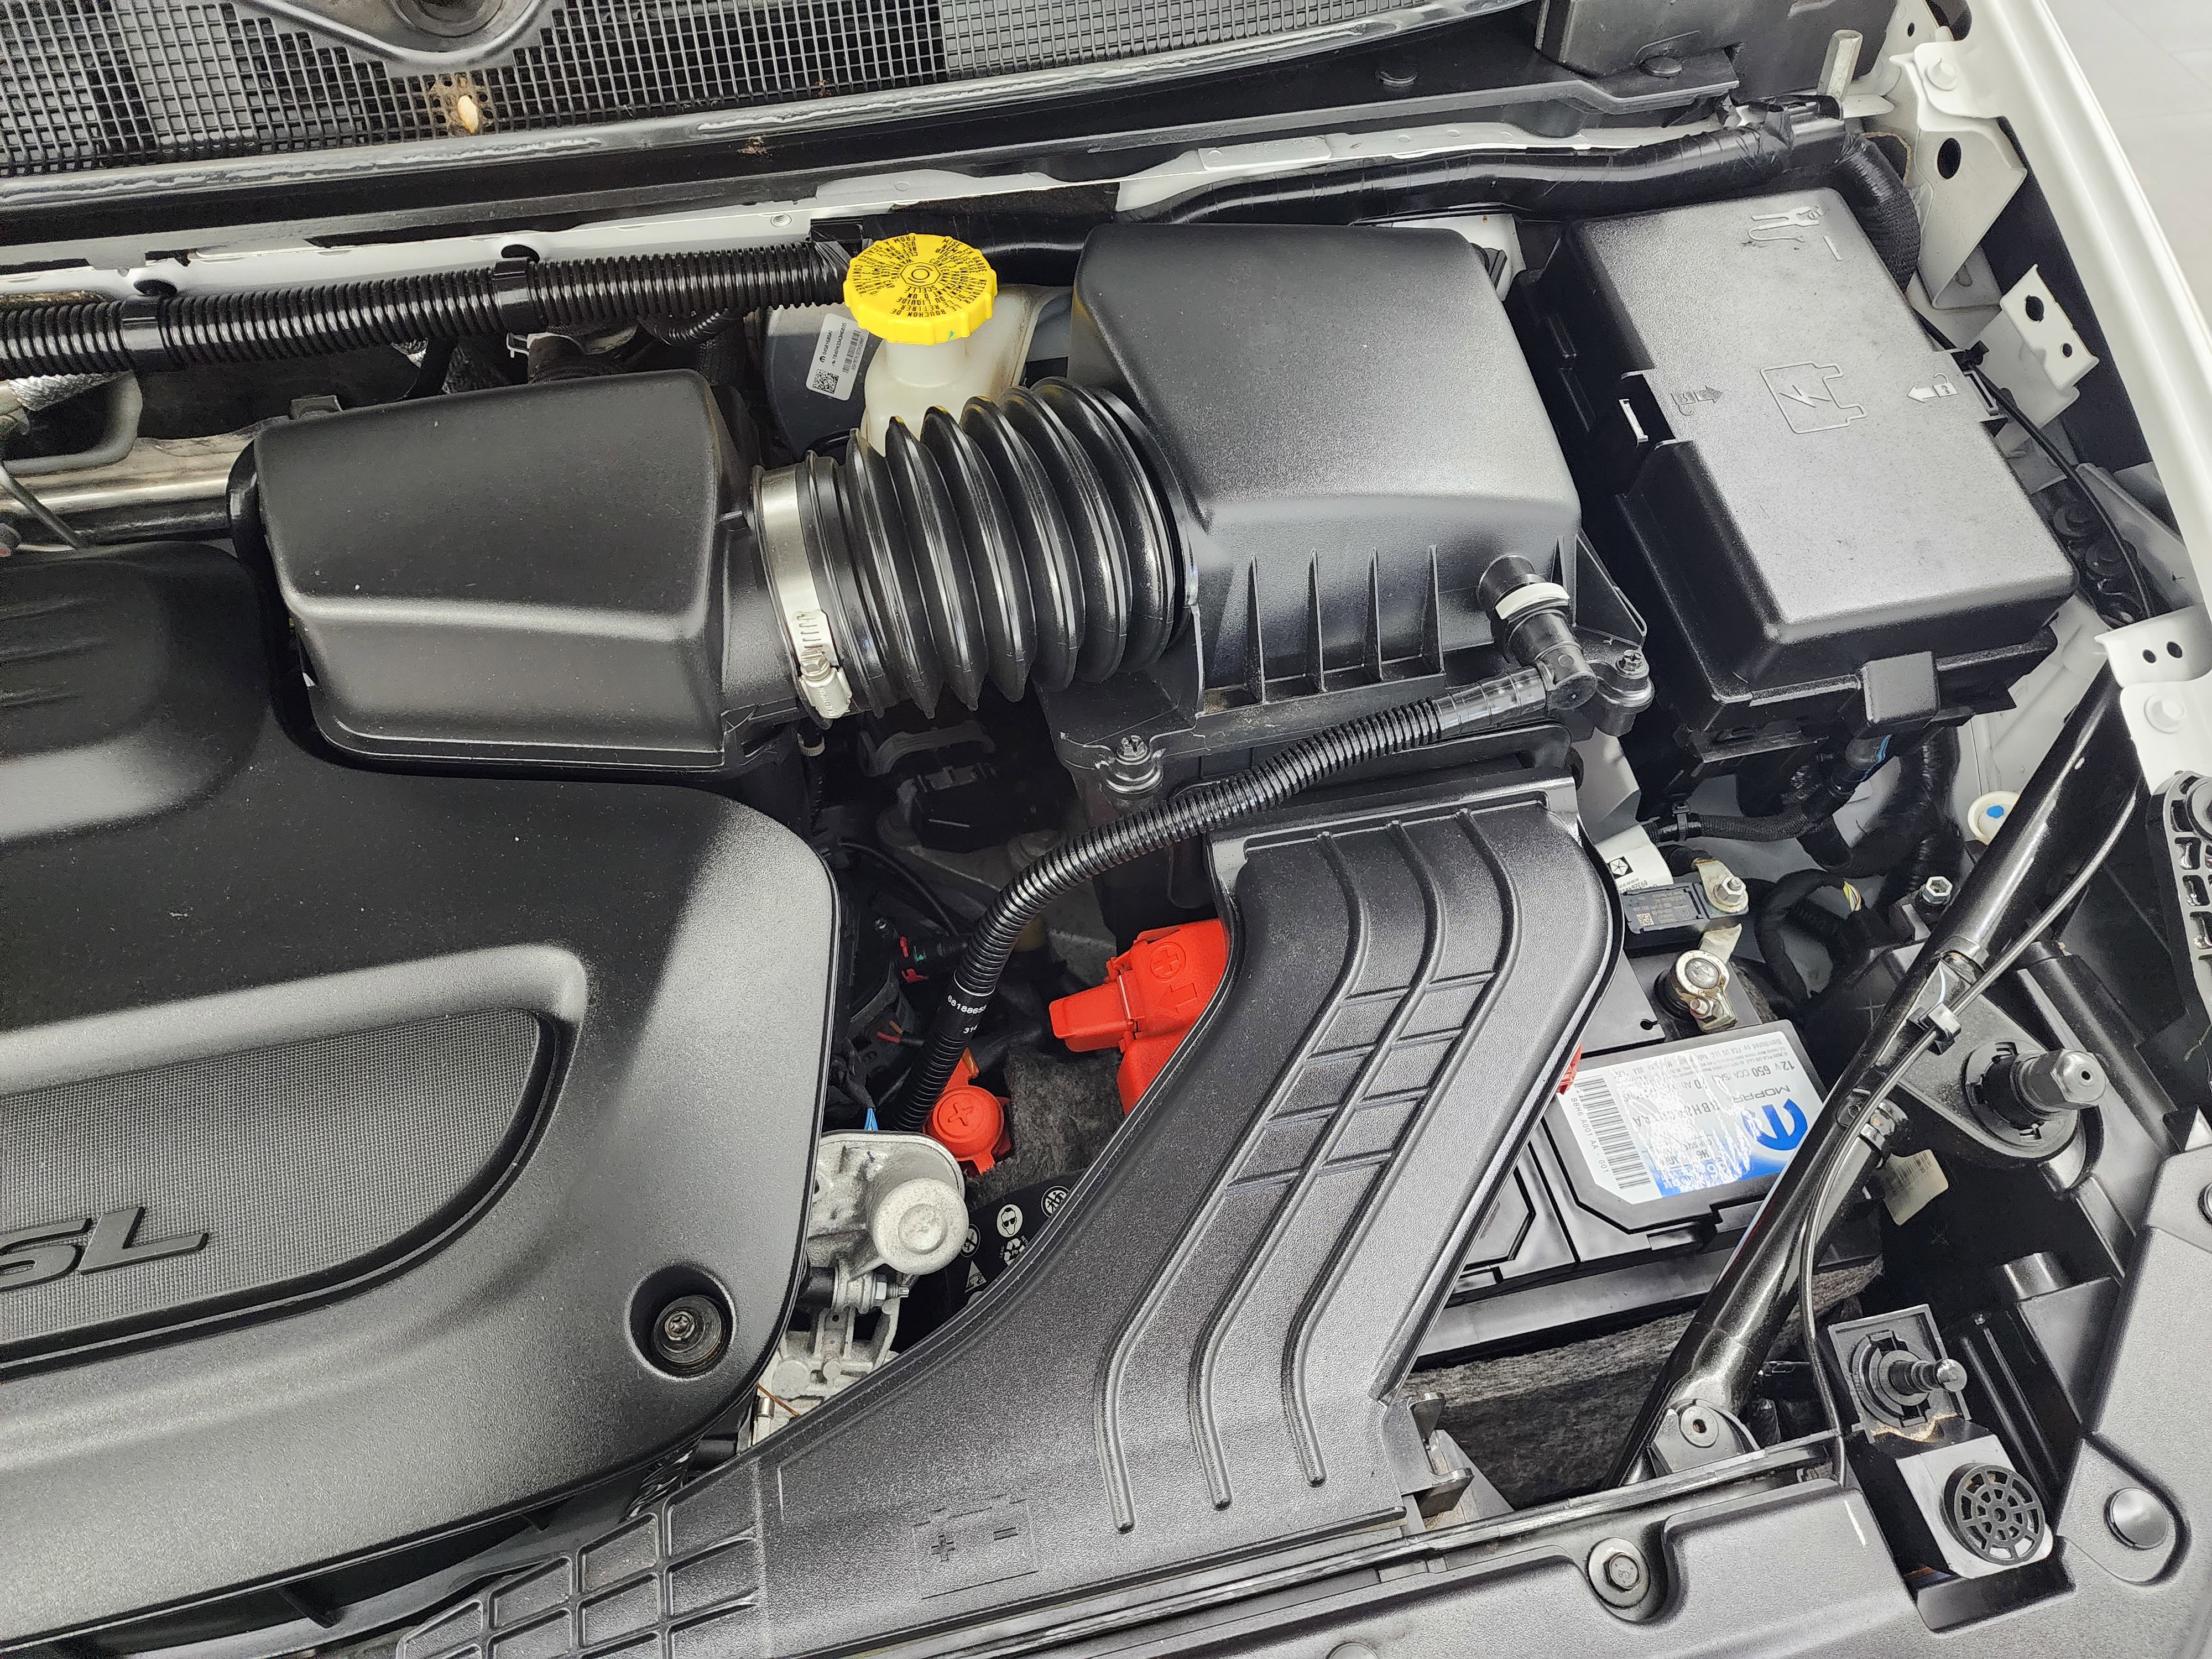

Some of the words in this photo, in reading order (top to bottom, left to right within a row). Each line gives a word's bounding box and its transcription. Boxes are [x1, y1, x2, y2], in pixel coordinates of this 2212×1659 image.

[892, 235, 916, 244] FROM
[942, 238, 963, 249] MISE
[858, 244, 883, 263] SEALED
[876, 246, 896, 257] ONLY
[884, 246, 917, 259] BEFORE
[895, 251, 919, 261] CLEAN
[935, 248, 964, 265] UTILISER
[962, 247, 974, 255] EN
[864, 258, 878, 268] DOT
[937, 255, 953, 264] DOT
[941, 244, 978, 274] REMPLISSAGE
[880, 260, 896, 278] FILLER
[891, 258, 911, 280] WARNING:
[972, 256, 987, 275] GARDE:
[871, 260, 886, 292] REMOVING.
[927, 258, 951, 287] CONTENANT
[852, 264, 867, 297] CONTAINER.
[862, 278, 878, 295] FLUID
[882, 280, 895, 289] CAP
[932, 270, 960, 298] PROVENANT
[947, 267, 969, 299] UNIQUEMENT
[963, 277, 978, 294] AVANT
[962, 279, 987, 304] NETTOYER
[896, 296, 931, 306] LIQUIDE
[942, 300, 954, 308] LE
[954, 294, 966, 302] DE
[900, 304, 940, 312] RETIRER.
[907, 309, 947, 318] BOUCHON
[949, 304, 962, 312] LE
[1733, 1069, 1749, 1079] CCA
[1751, 1065, 1771, 1077] 650
[1681, 1081, 1692, 1090] Ah
[1732, 1084, 1791, 1103] MOPAR
[1571, 1097, 1584, 1117] BBH6
[1580, 1118, 1593, 1137] A001
[1589, 1138, 1599, 1150] AA
[1598, 1159, 1609, 1174] 001
[1695, 1149, 1709, 1159] H6
